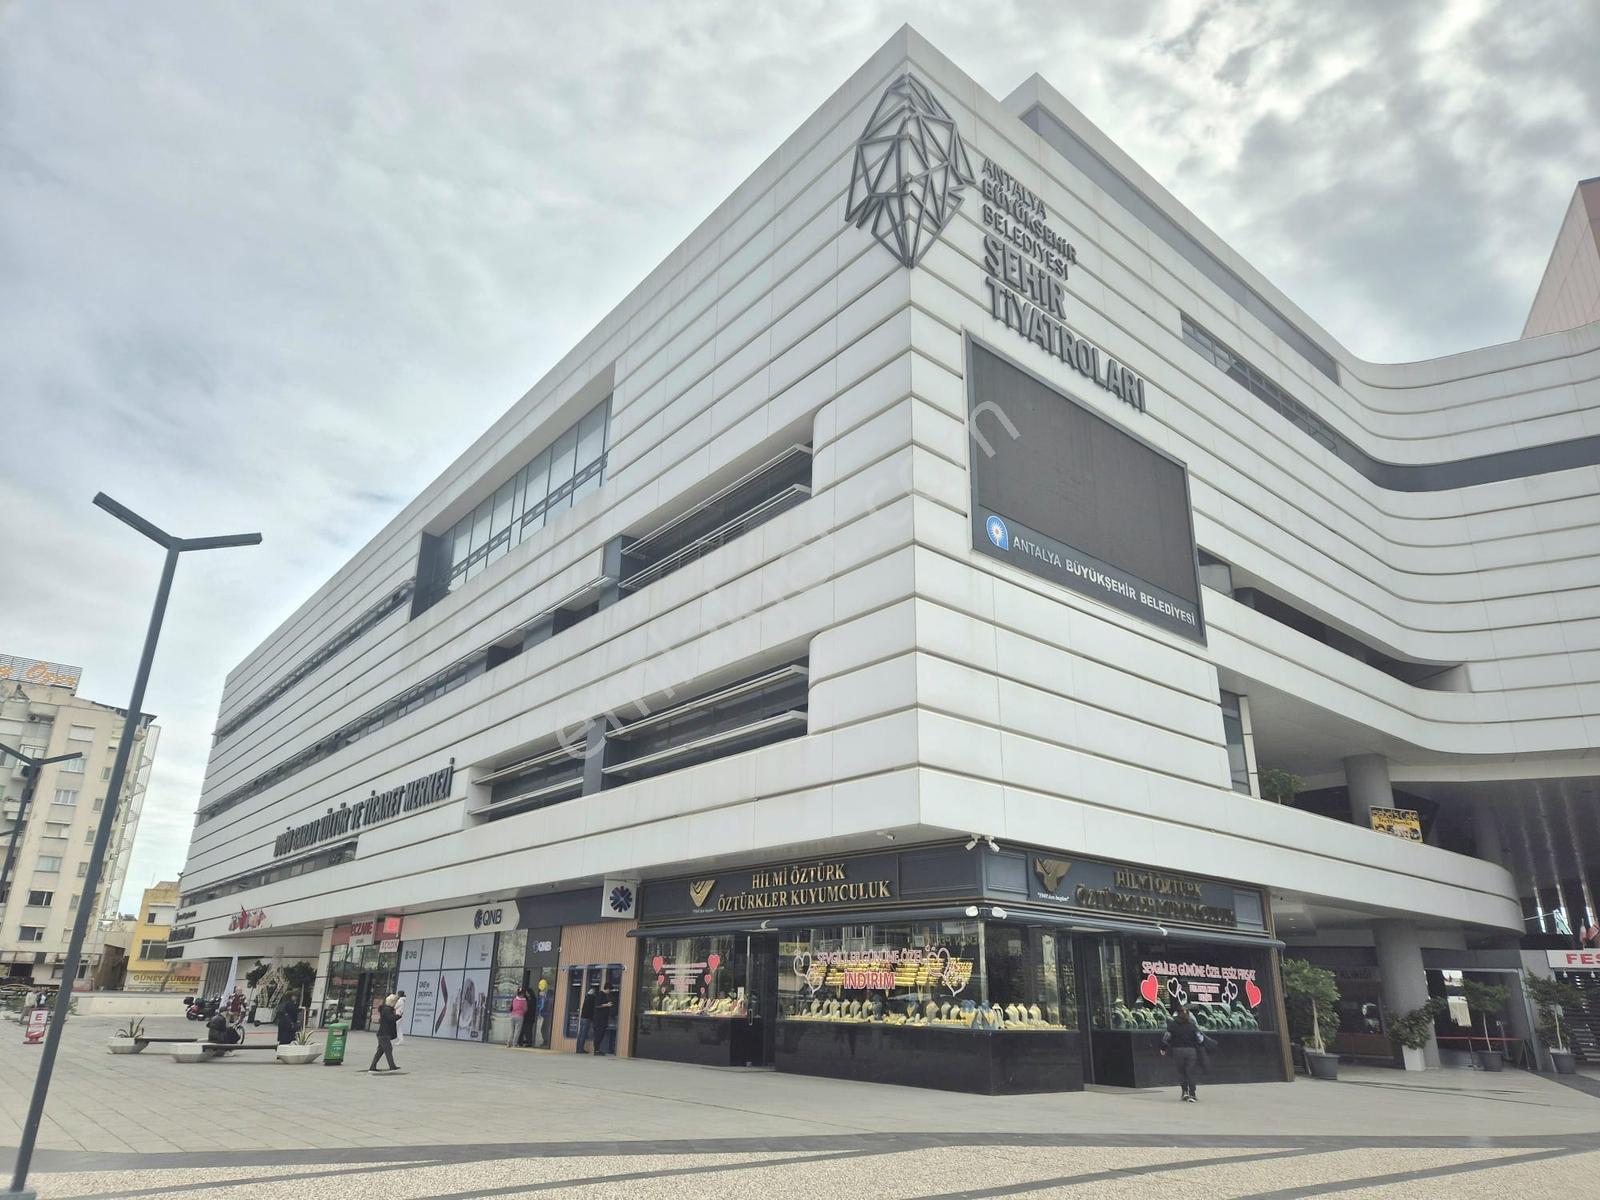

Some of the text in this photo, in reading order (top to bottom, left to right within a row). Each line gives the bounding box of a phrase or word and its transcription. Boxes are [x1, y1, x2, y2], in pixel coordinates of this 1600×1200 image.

[982, 158, 1047, 220] ANTALYA
[1013, 535, 1196, 626] ANTALYA BÜYÜKŞEHİR BELEDİYESİ
[791, 863, 846, 885] ÖZTÜRK
[717, 880, 891, 912] ÖZTÜRKLER KUYUMCULUK
[483, 909, 503, 926] QNB
[843, 969, 896, 990] İNDİRİM
